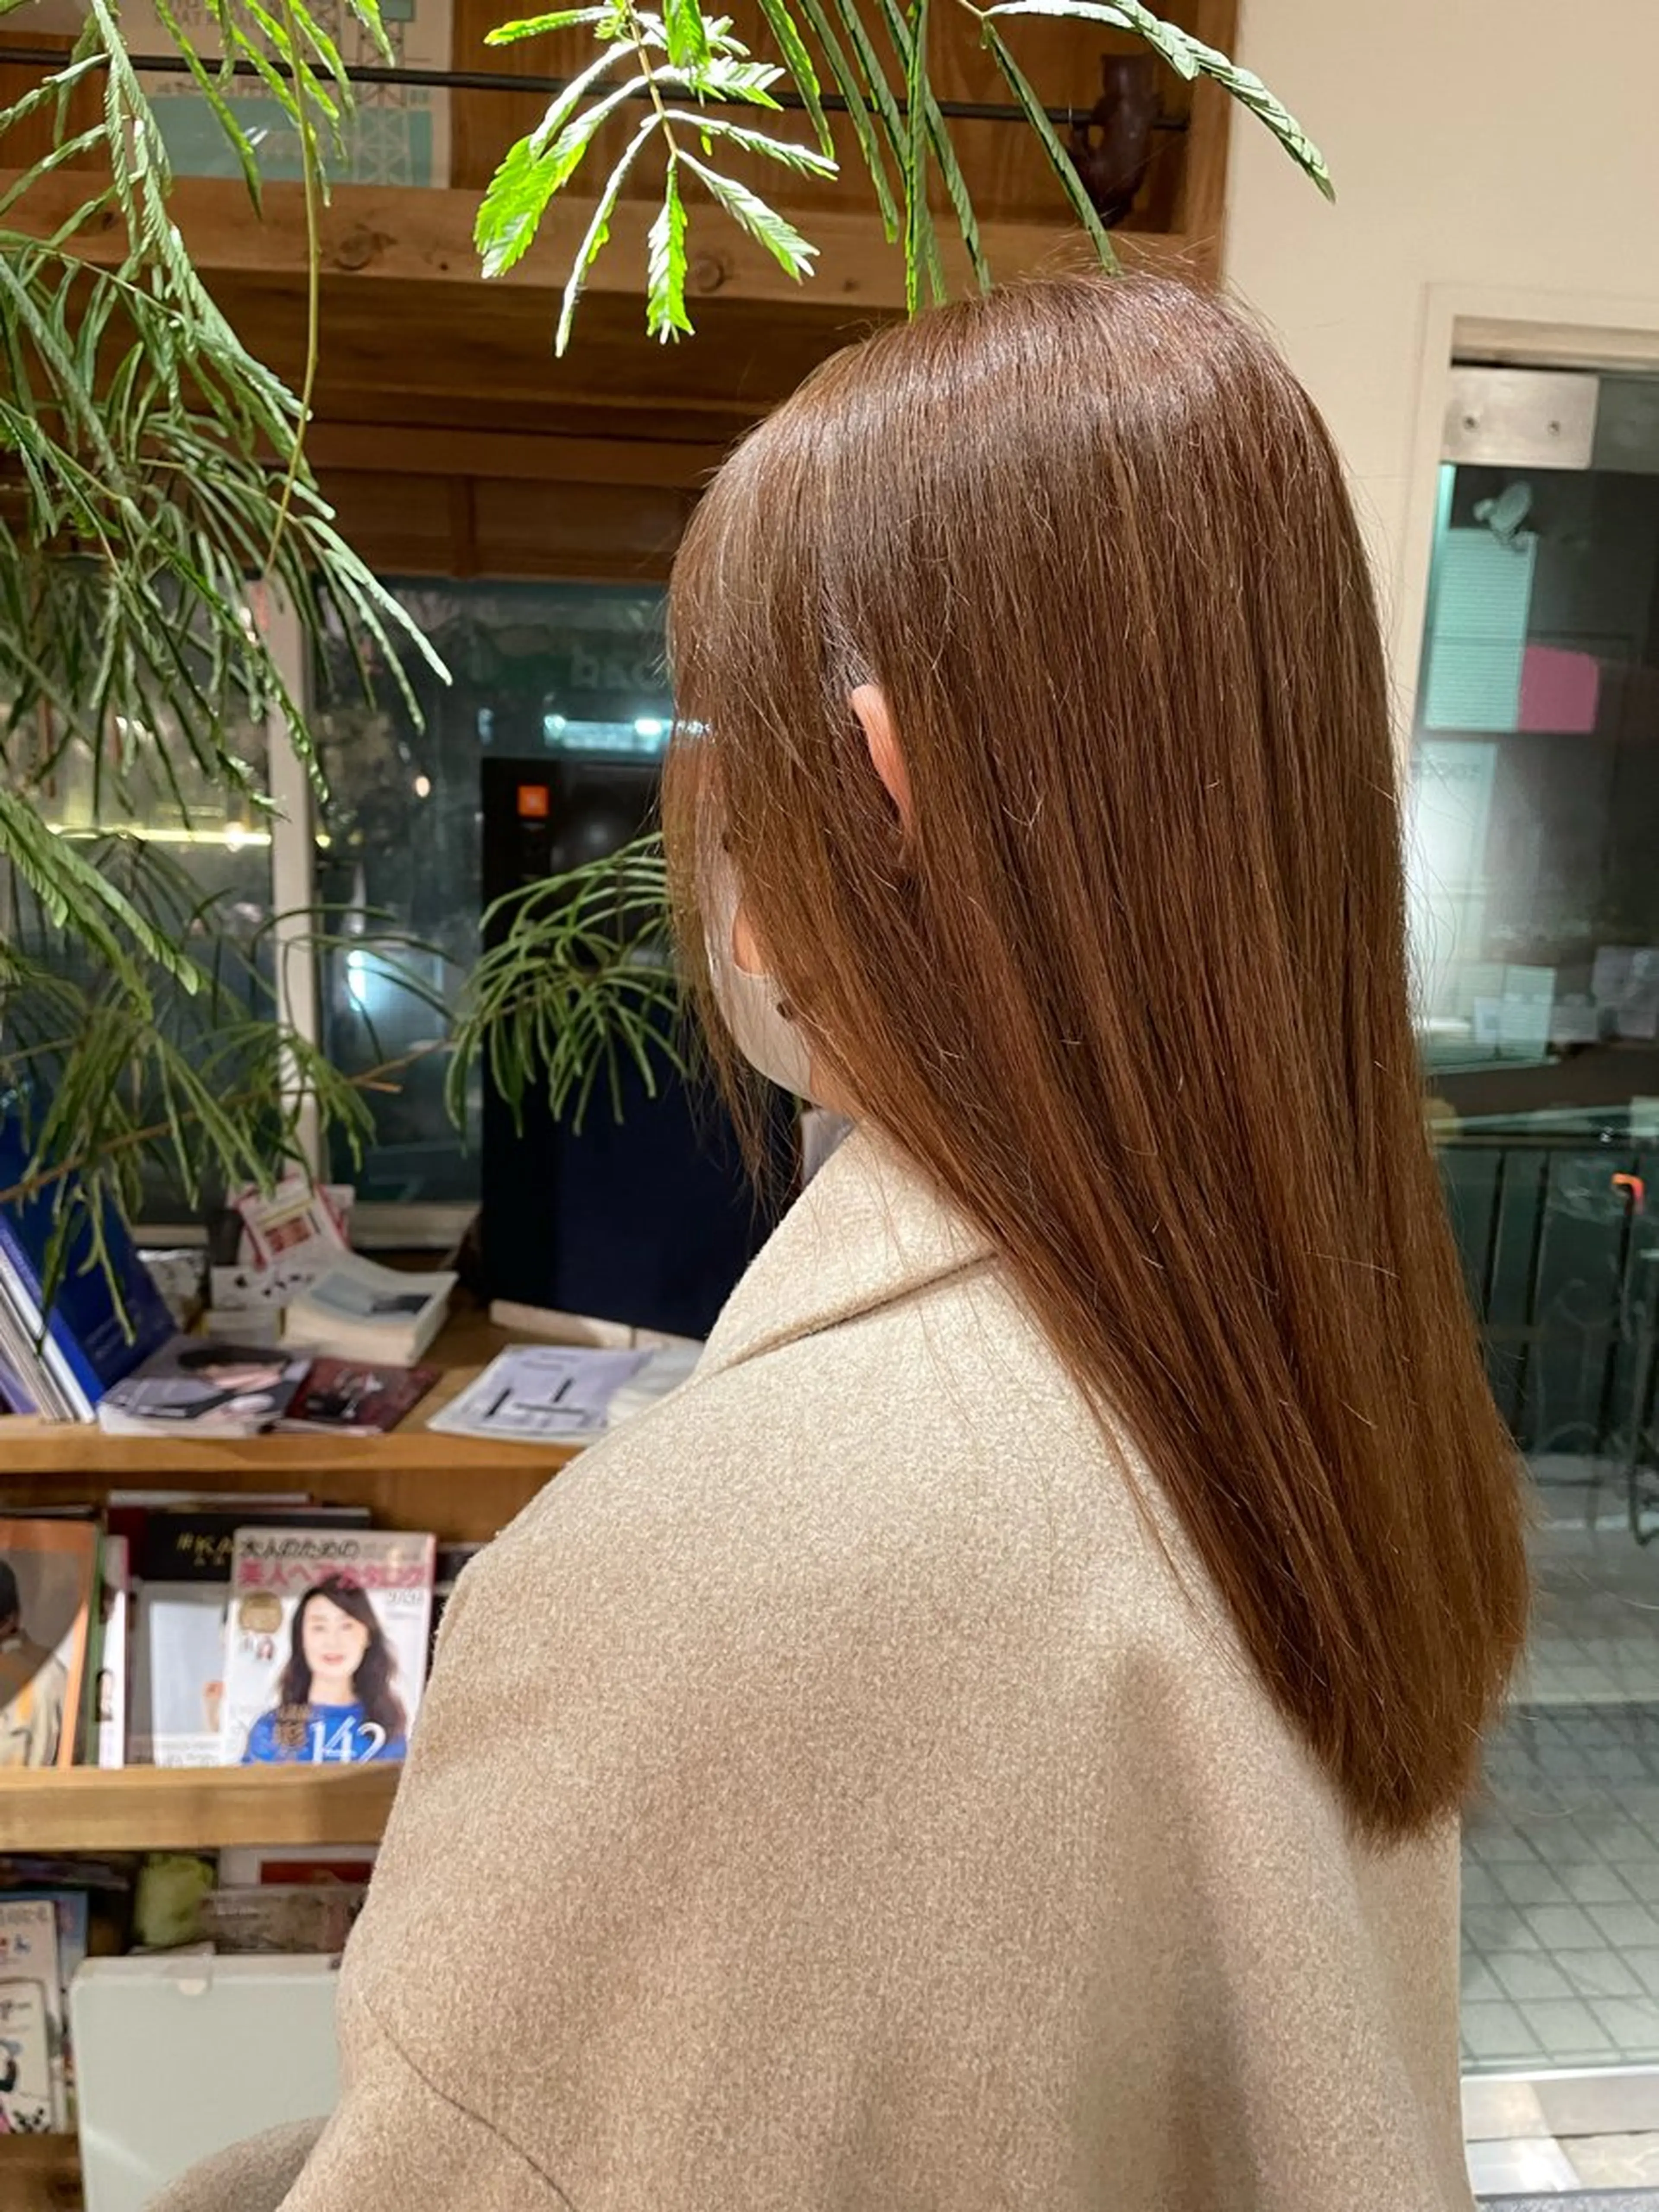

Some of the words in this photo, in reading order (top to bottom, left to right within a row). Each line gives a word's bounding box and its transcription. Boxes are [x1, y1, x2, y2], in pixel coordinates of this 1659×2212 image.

[240, 1534, 361, 1558] 大人のための
[309, 1715, 386, 1764] 142
